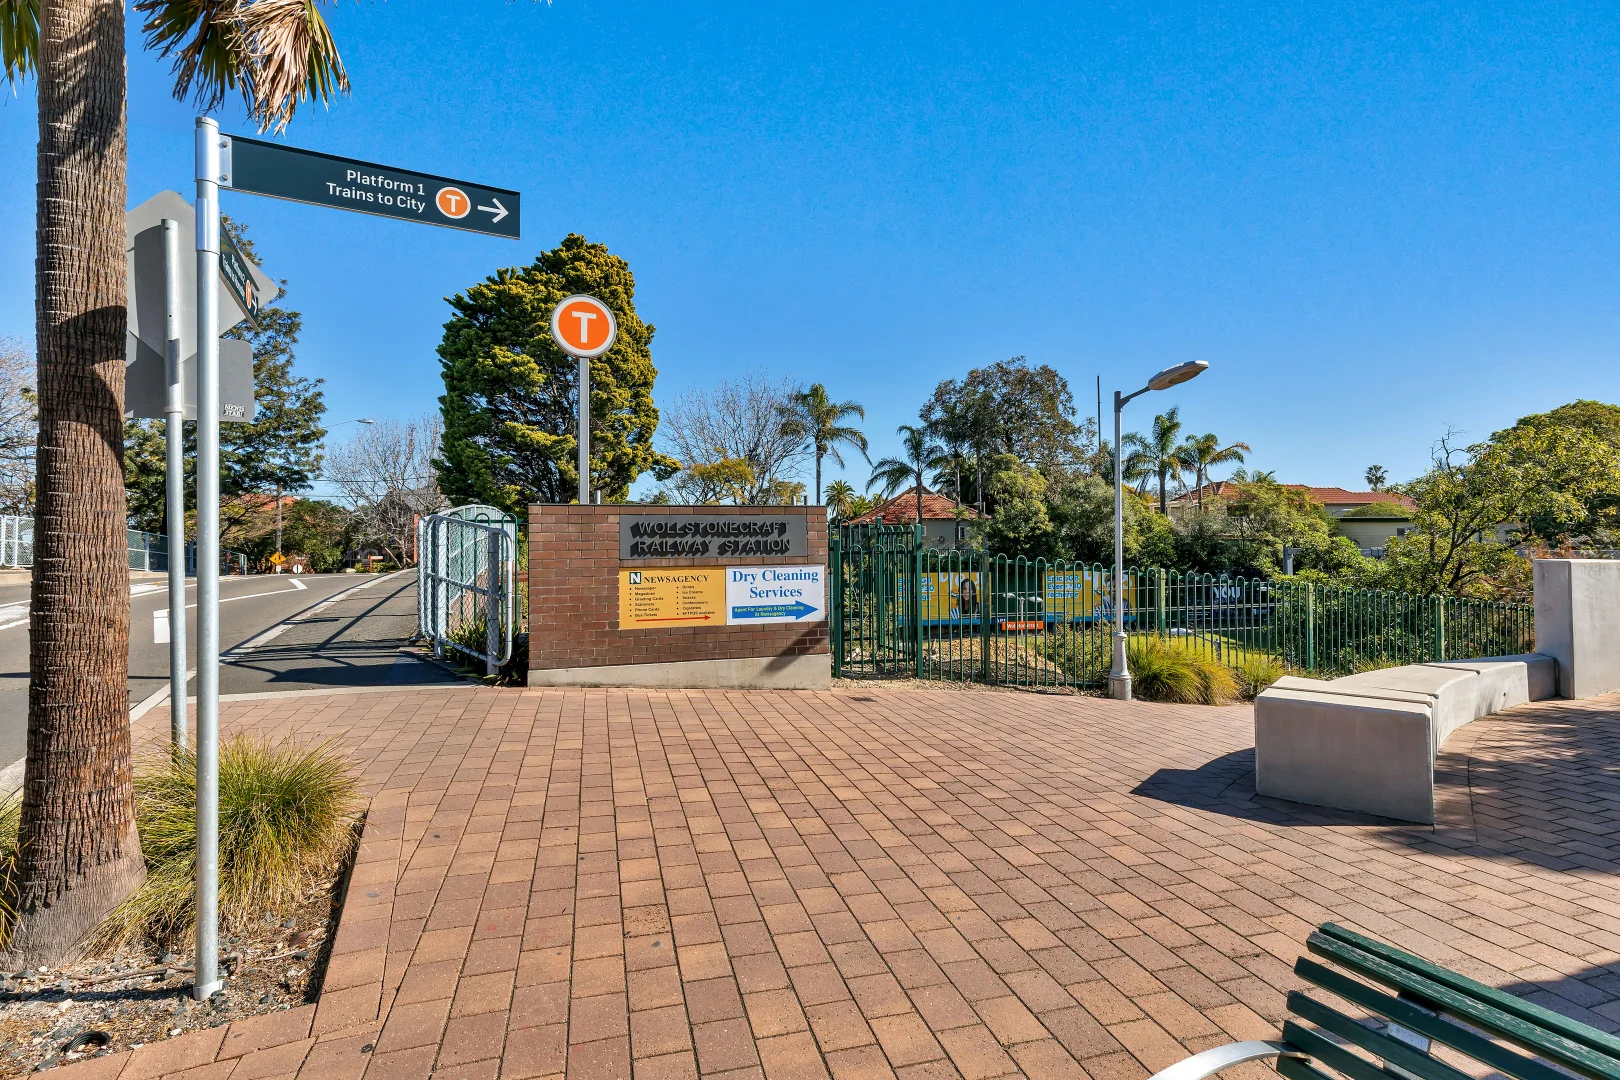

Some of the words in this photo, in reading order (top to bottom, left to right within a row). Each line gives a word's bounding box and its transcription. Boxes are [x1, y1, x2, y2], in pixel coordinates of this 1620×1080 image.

[347, 170, 414, 193] Platform
[418, 184, 425, 196] 1
[326, 182, 374, 202] Trains
[377, 193, 393, 205] to
[397, 196, 426, 213] City
[446, 194, 460, 212] T
[572, 310, 597, 344] T
[636, 521, 790, 536] WOLLSTONECRAFT
[636, 539, 714, 554] RAILWAY
[722, 538, 791, 553] STATION
[644, 575, 710, 584] NEWSAGENCY
[732, 570, 757, 584] Dry
[762, 569, 819, 583] Cleaning
[750, 586, 802, 599] Services
